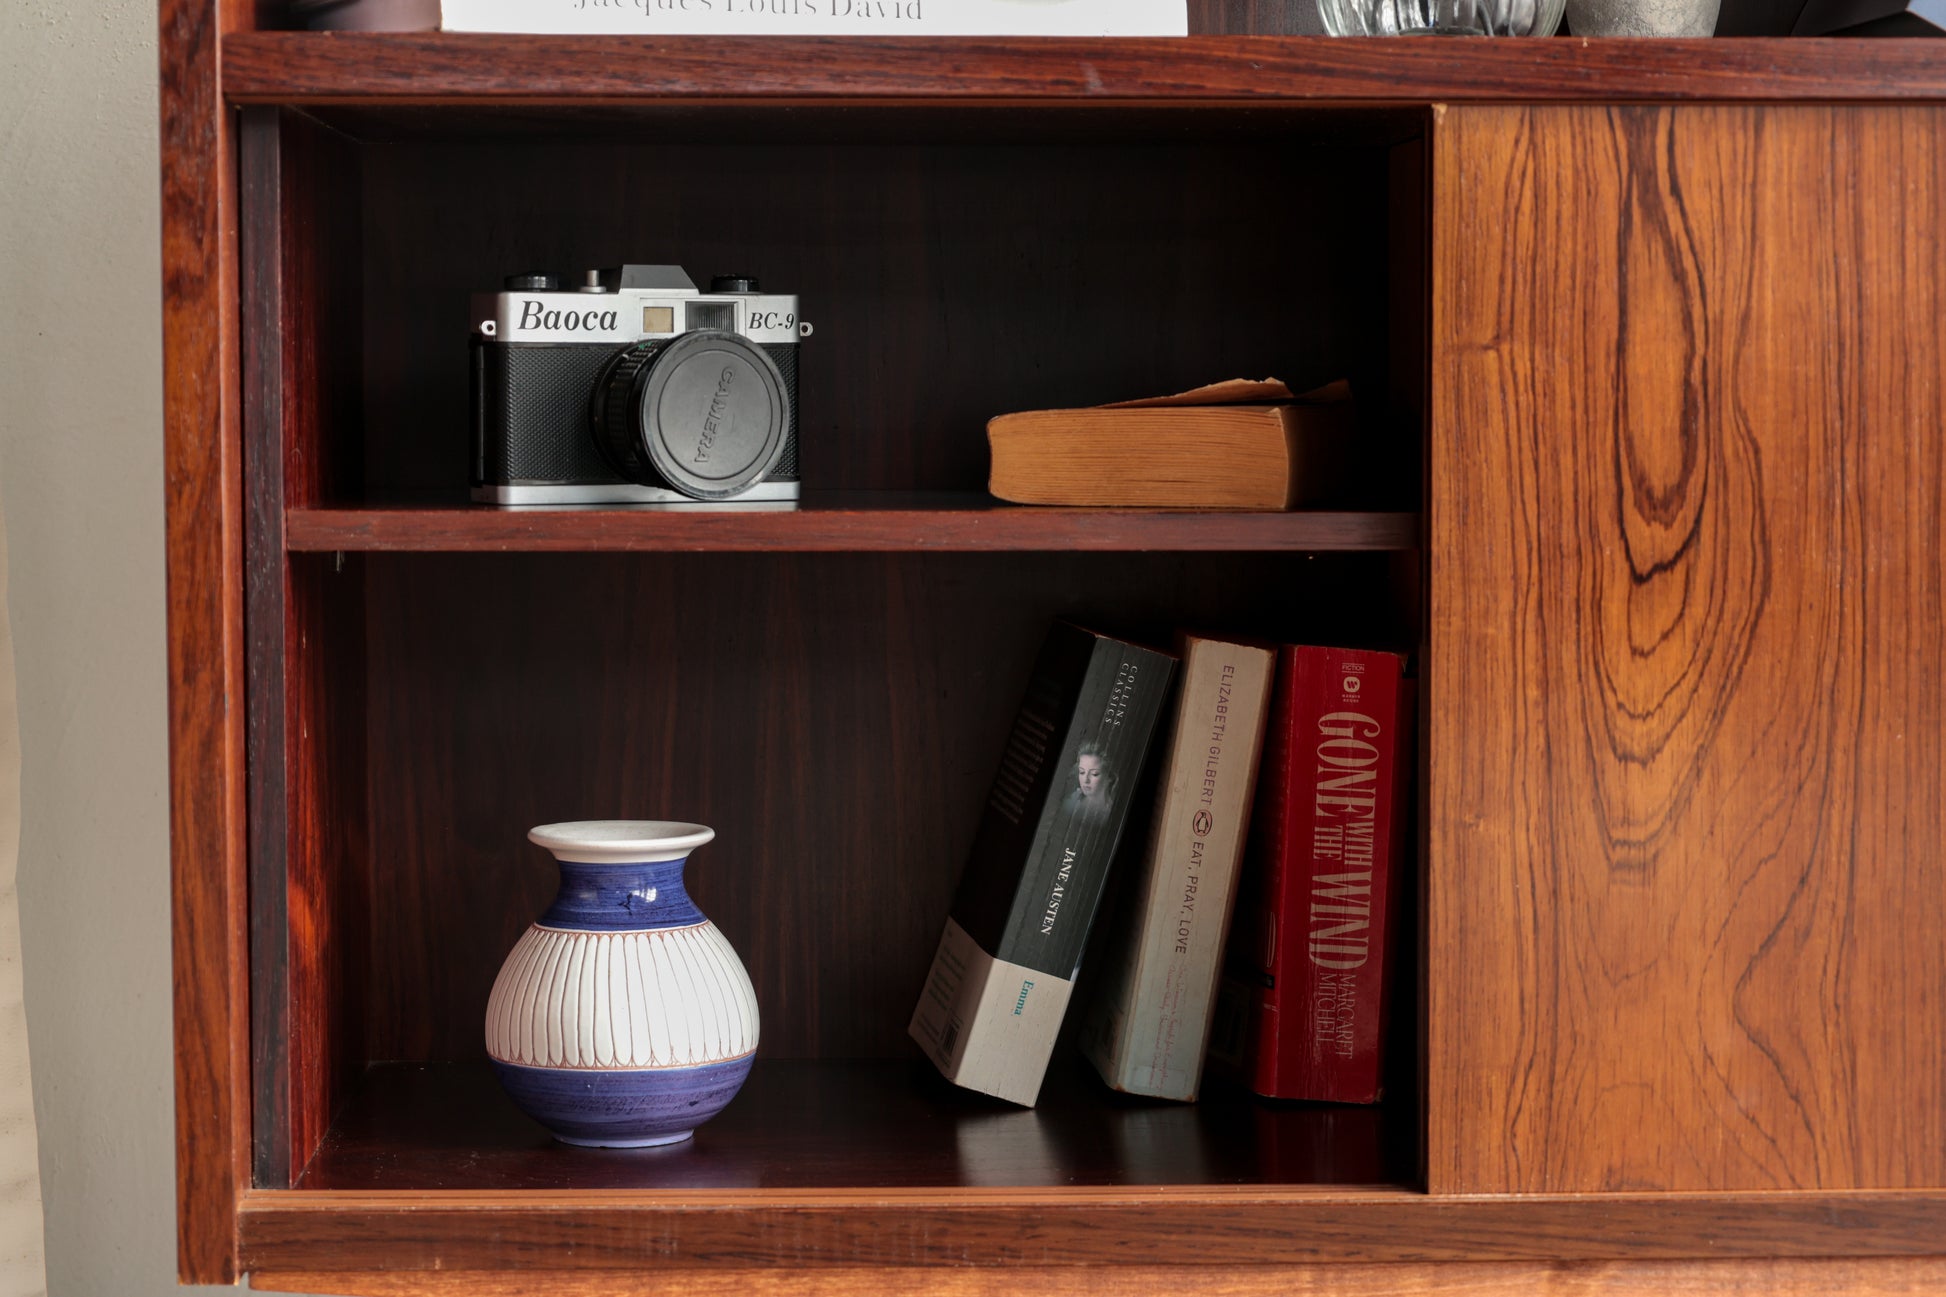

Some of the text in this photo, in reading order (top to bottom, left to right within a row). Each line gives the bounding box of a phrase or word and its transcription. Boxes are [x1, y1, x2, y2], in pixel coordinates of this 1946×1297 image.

[831, 0, 922, 20] David
[517, 300, 618, 331] Baoca
[748, 311, 795, 330] BC-9
[693, 366, 735, 463] CAMERA
[1105, 663, 1129, 723] CLASSICS
[1114, 665, 1138, 726] COLLINS
[1211, 664, 1235, 742] ELIZABETH
[1309, 711, 1380, 969] GONE WITH THE WIND
[1040, 847, 1077, 935] JANE AUSTEN
[1175, 919, 1191, 954] LOVE
[1013, 979, 1035, 1016] Emma
[1316, 973, 1337, 1046] MITCHELL
[1335, 974, 1357, 1059] MARGARET
